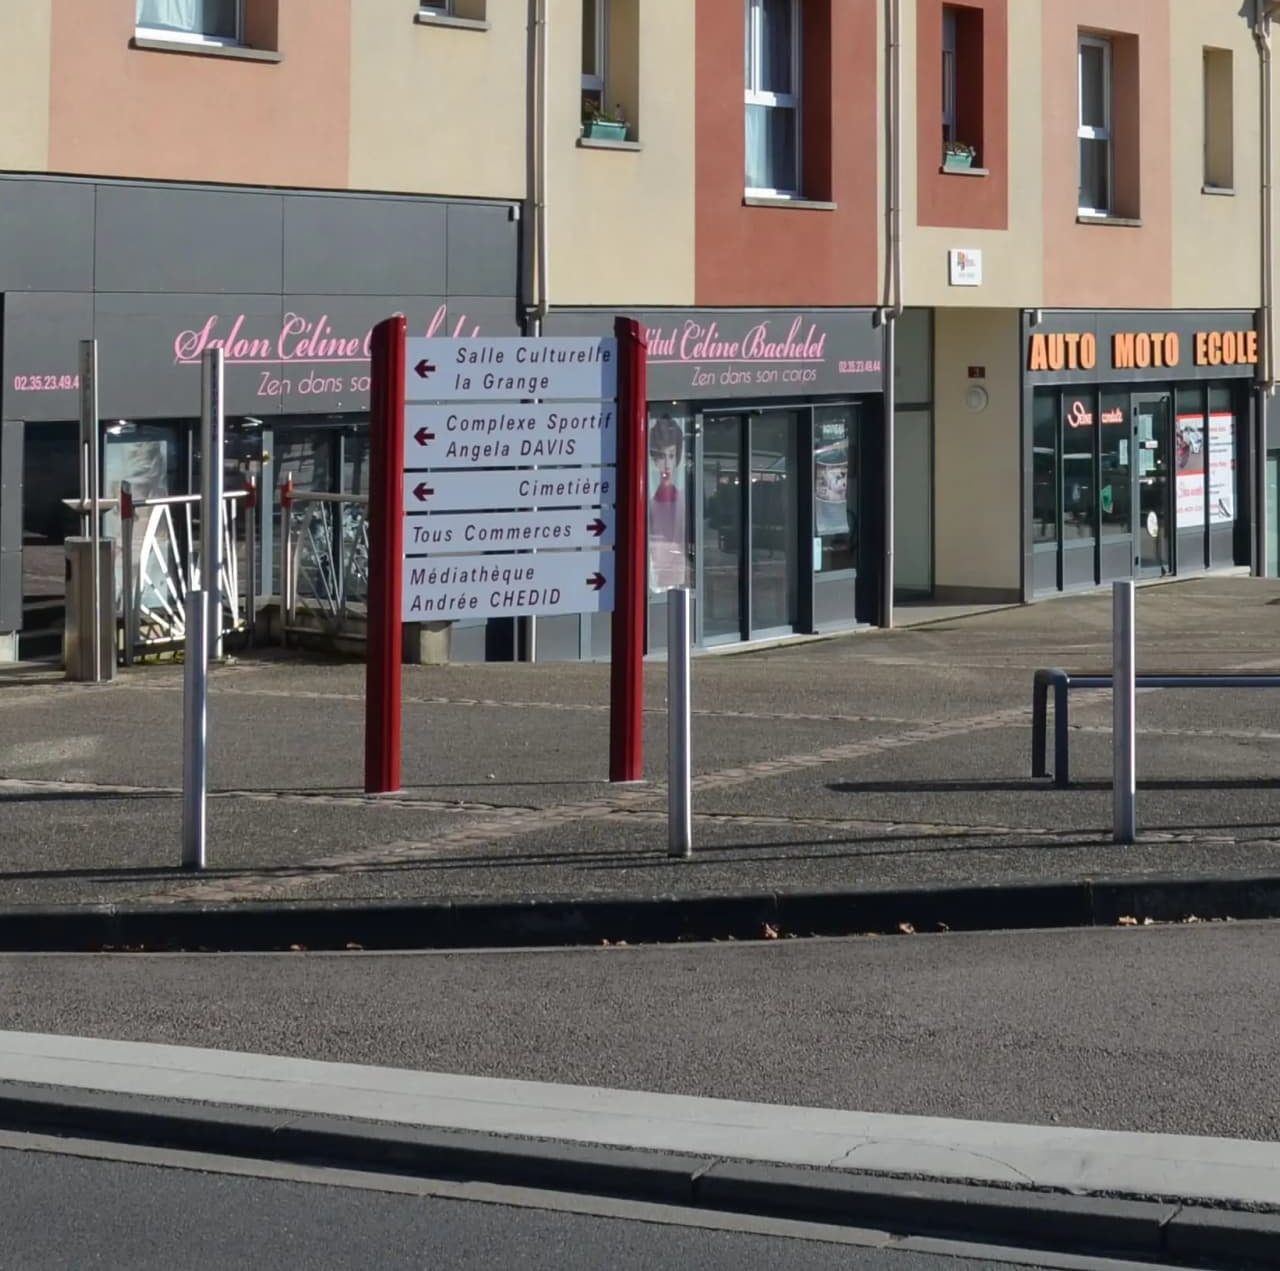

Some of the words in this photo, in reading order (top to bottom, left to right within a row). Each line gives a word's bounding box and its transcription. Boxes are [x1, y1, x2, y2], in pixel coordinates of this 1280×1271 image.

[277, 312, 360, 361] Céline
[679, 319, 738, 361] Céline
[741, 315, 827, 360] Bachelet
[456, 347, 505, 364] Salle
[516, 345, 612, 364] Culturelle
[1028, 332, 1096, 371] AUTO
[1112, 331, 1180, 369] MOTO
[1194, 330, 1258, 366] ECOLE
[13, 375, 80, 391] 02.35.23.49.4
[256, 371, 291, 396] Zen
[297, 370, 343, 394] dans
[454, 374, 472, 390] la
[483, 373, 549, 393] Grange
[691, 366, 716, 386] Zen
[720, 365, 752, 385] dans
[756, 370, 778, 384] son
[782, 368, 817, 385] corps
[446, 414, 536, 435] Complexe
[547, 412, 614, 433] Sportif
[446, 441, 510, 461] Angela
[520, 439, 577, 457] DAVIS
[519, 479, 610, 497] Cimetière
[413, 526, 453, 543] Tous
[464, 524, 572, 542] Commerces
[410, 565, 535, 585] Médiathèque
[410, 594, 478, 612] Andrée
[489, 588, 561, 608] CHEDID
